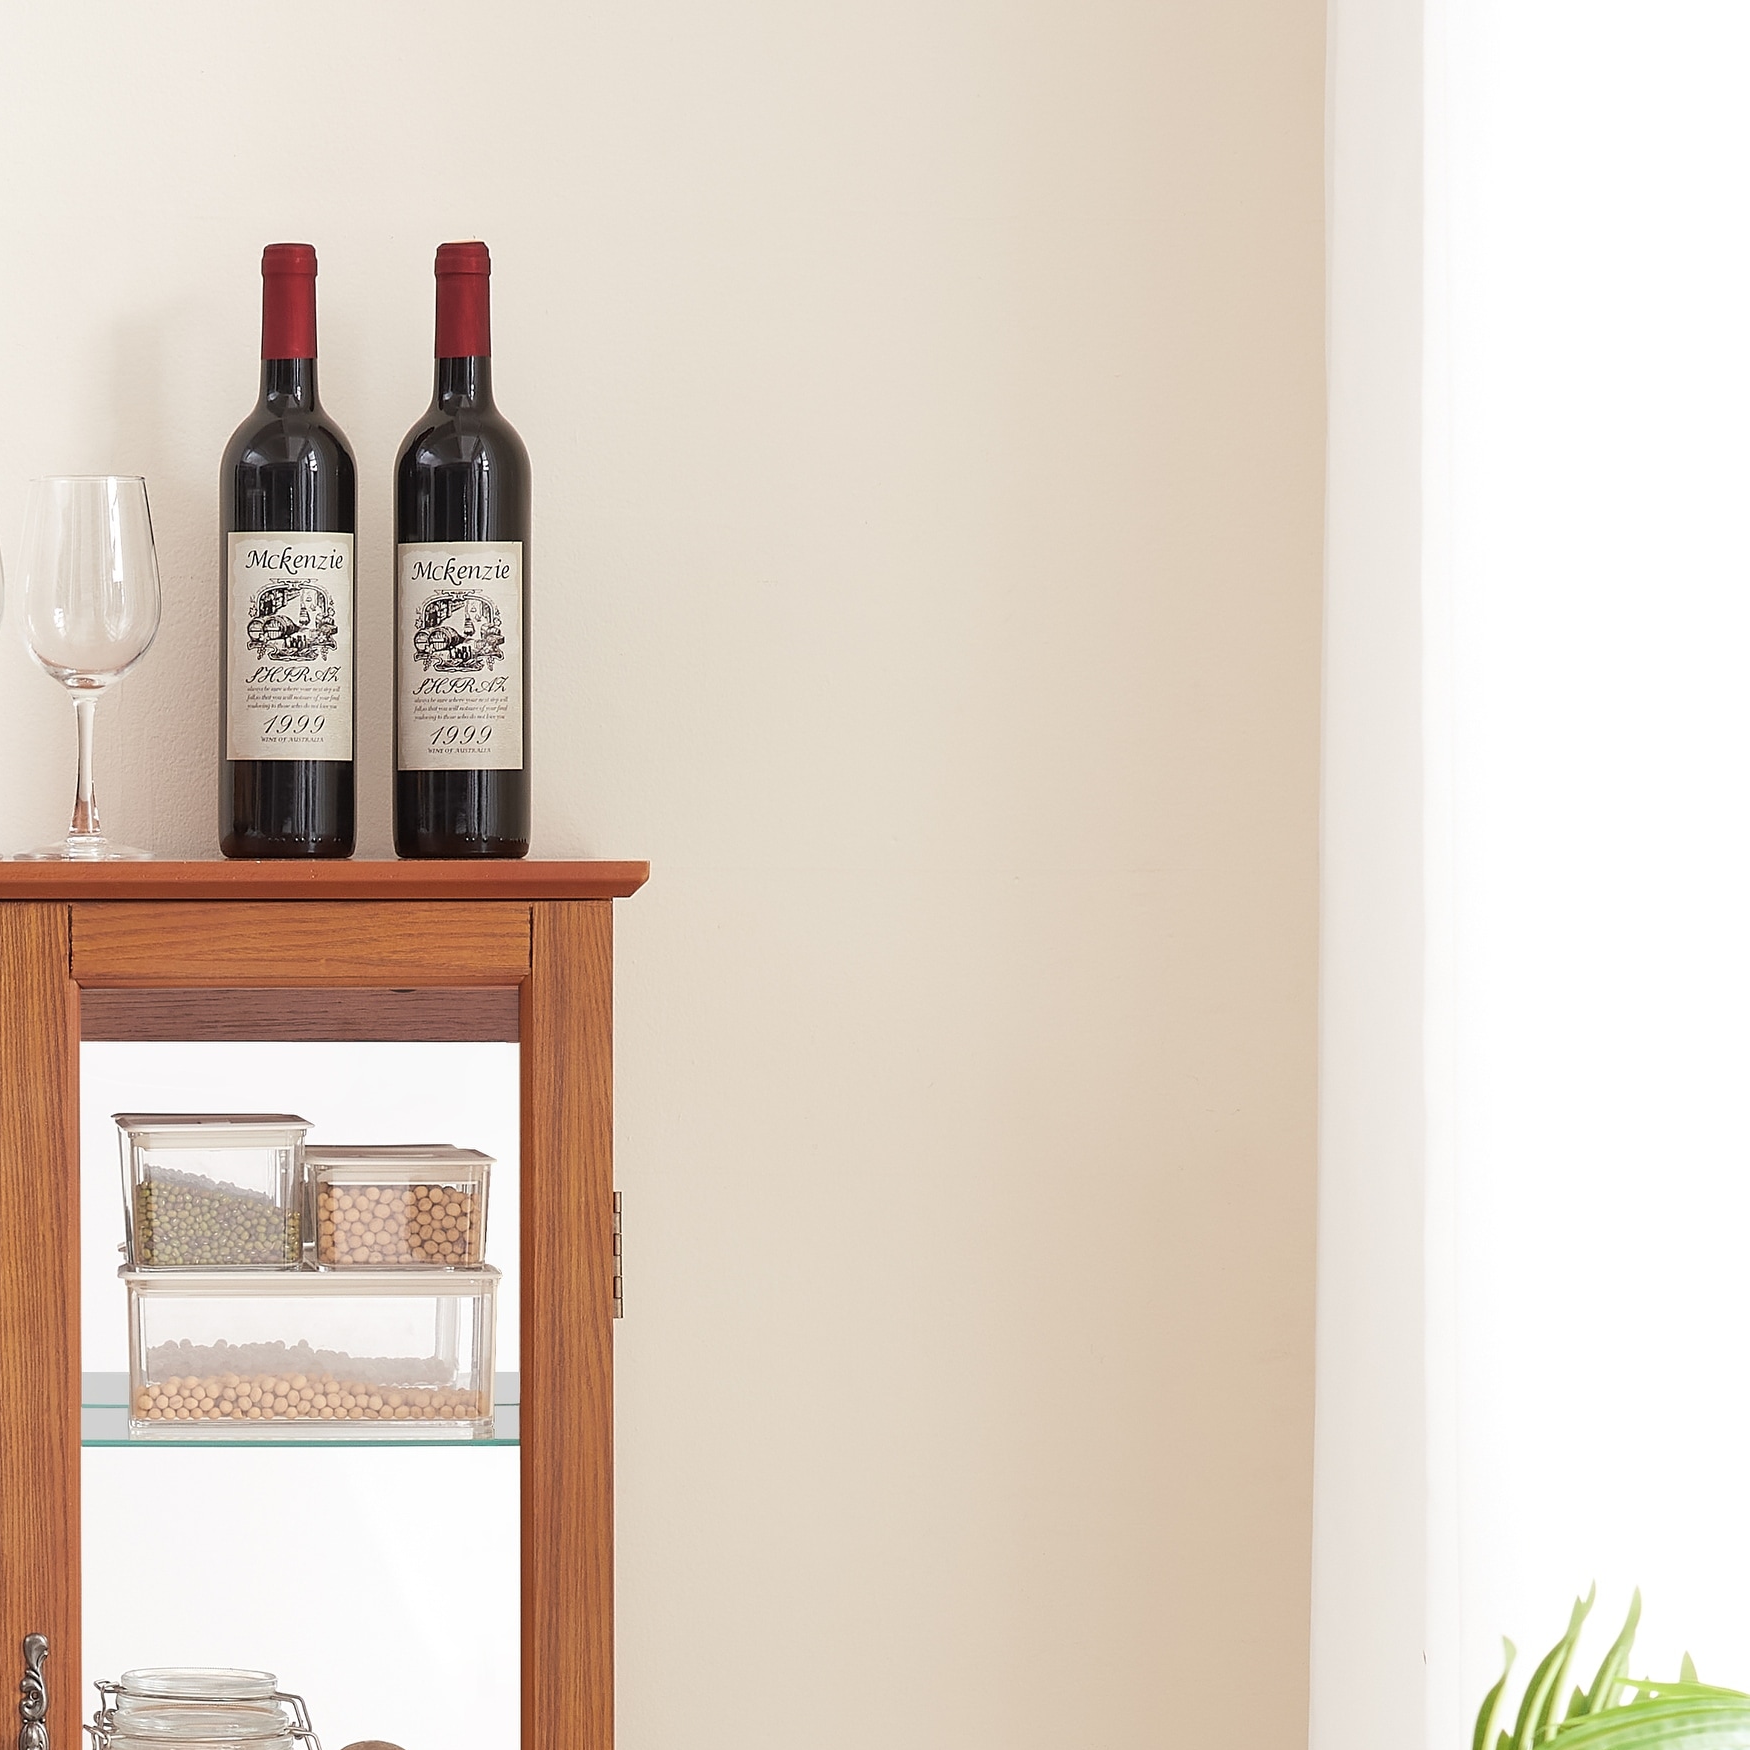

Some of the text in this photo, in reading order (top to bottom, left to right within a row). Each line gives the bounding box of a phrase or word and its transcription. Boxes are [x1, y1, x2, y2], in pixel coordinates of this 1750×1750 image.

[245, 546, 343, 575] Mckenzie
[411, 557, 510, 586] Mckenzie
[245, 666, 341, 684] SHIRAZ
[413, 676, 509, 695] SHIRAZ
[263, 714, 326, 734] 1999
[430, 725, 492, 745] 1999
